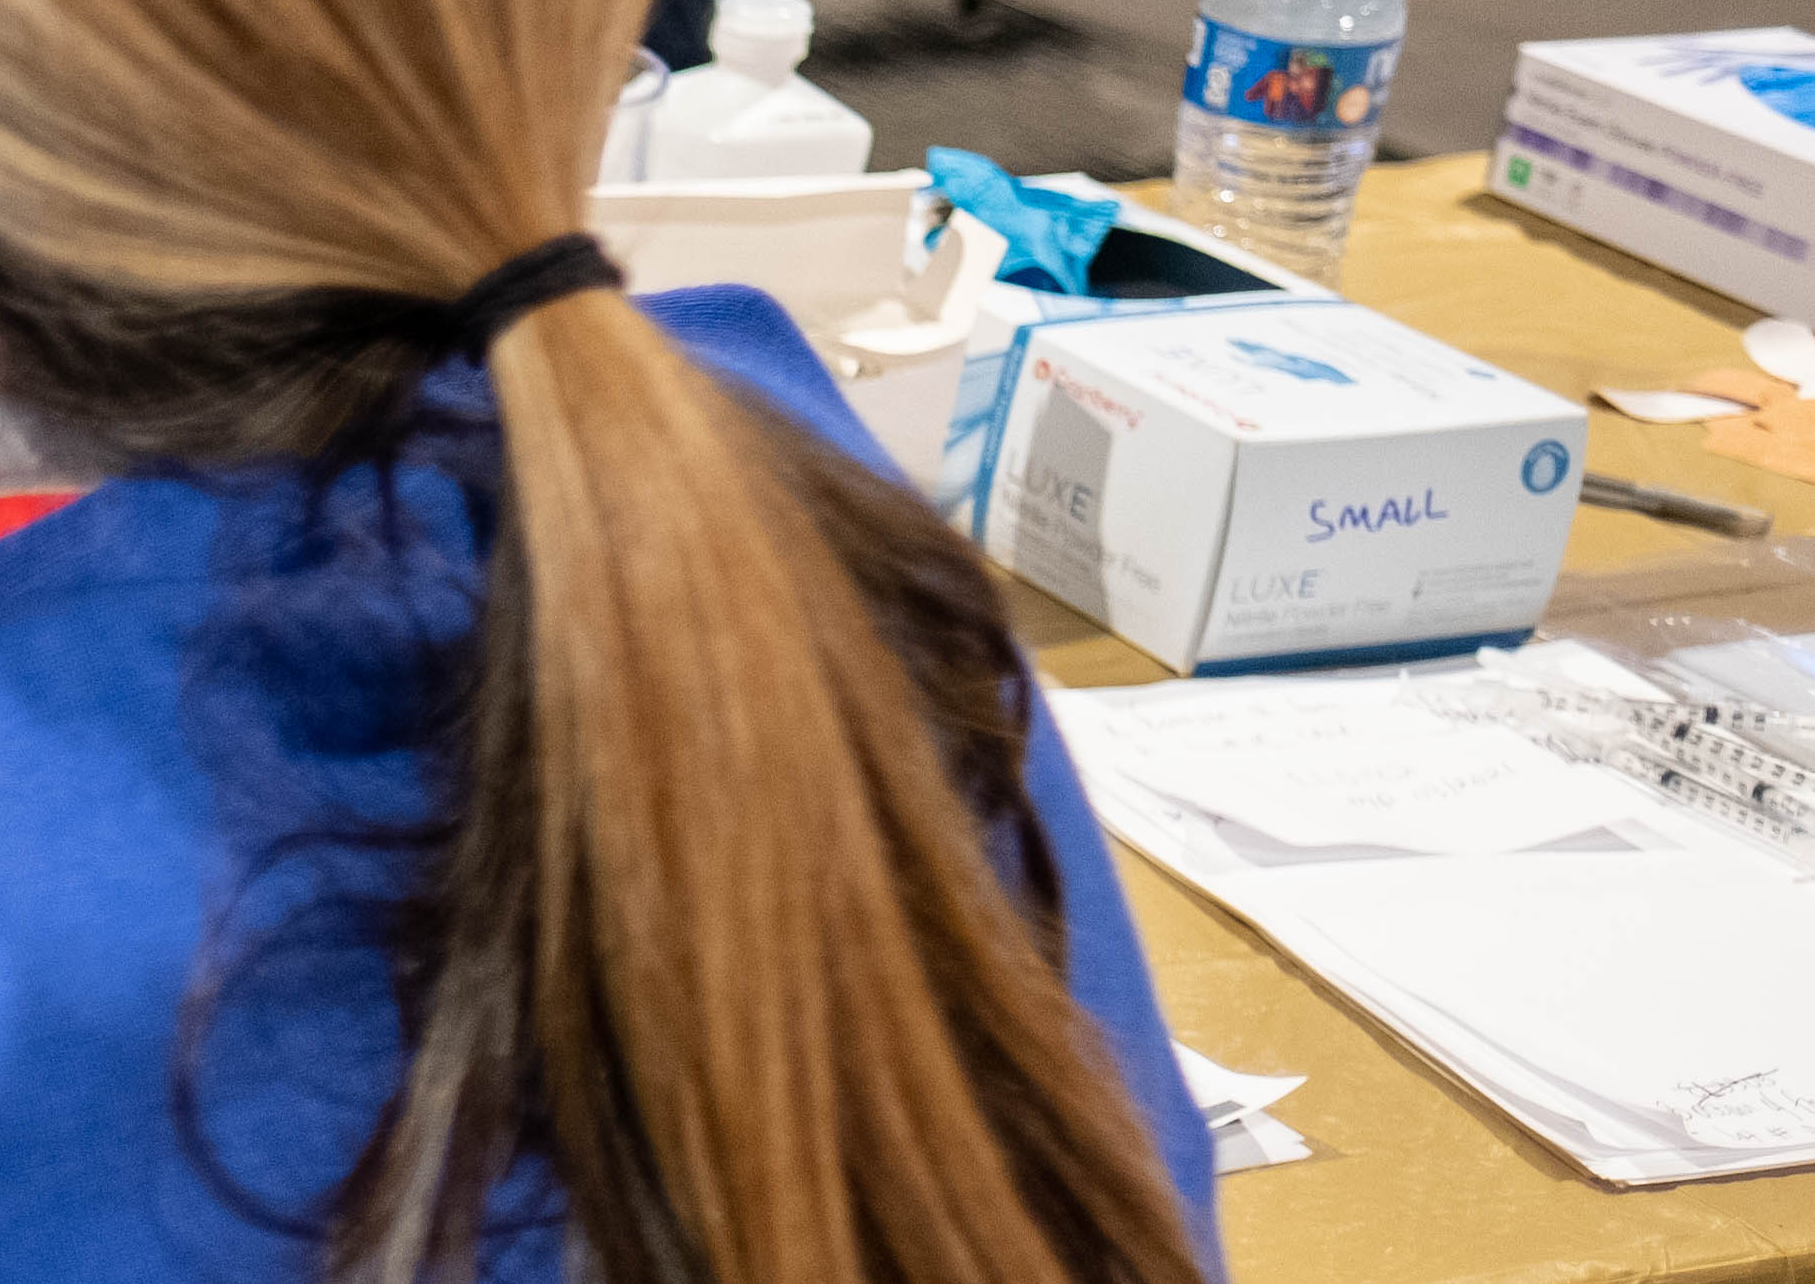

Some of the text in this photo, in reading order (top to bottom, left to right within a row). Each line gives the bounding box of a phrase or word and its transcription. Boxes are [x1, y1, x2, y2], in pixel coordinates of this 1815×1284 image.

[1007, 447, 1093, 524] LUXE
[1306, 488, 1448, 543] SMALL
[1229, 569, 1320, 605] LUXE
